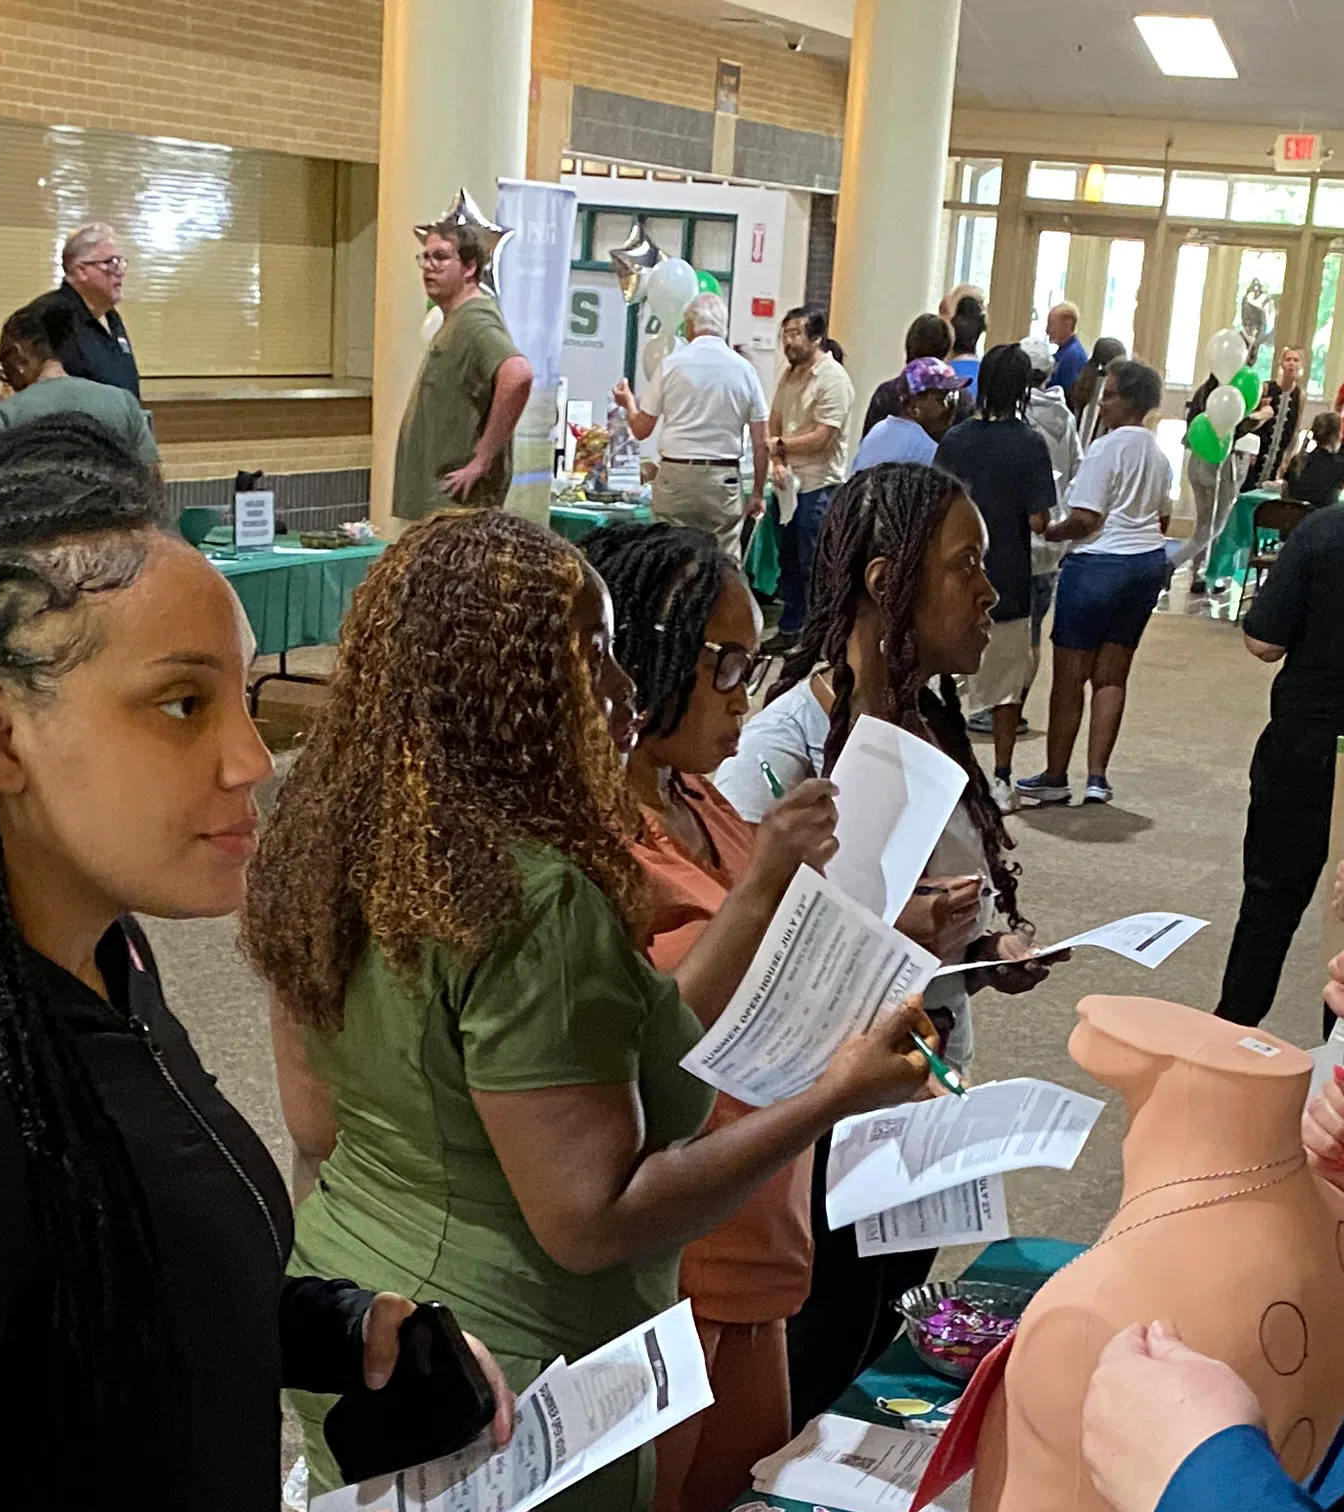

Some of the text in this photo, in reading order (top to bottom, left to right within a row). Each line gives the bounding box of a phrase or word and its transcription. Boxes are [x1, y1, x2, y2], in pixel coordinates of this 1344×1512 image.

[1284, 136, 1314, 161] EXIT
[570, 291, 600, 335] S
[737, 992, 763, 1025] OPEN
[778, 917, 799, 949] JULY
